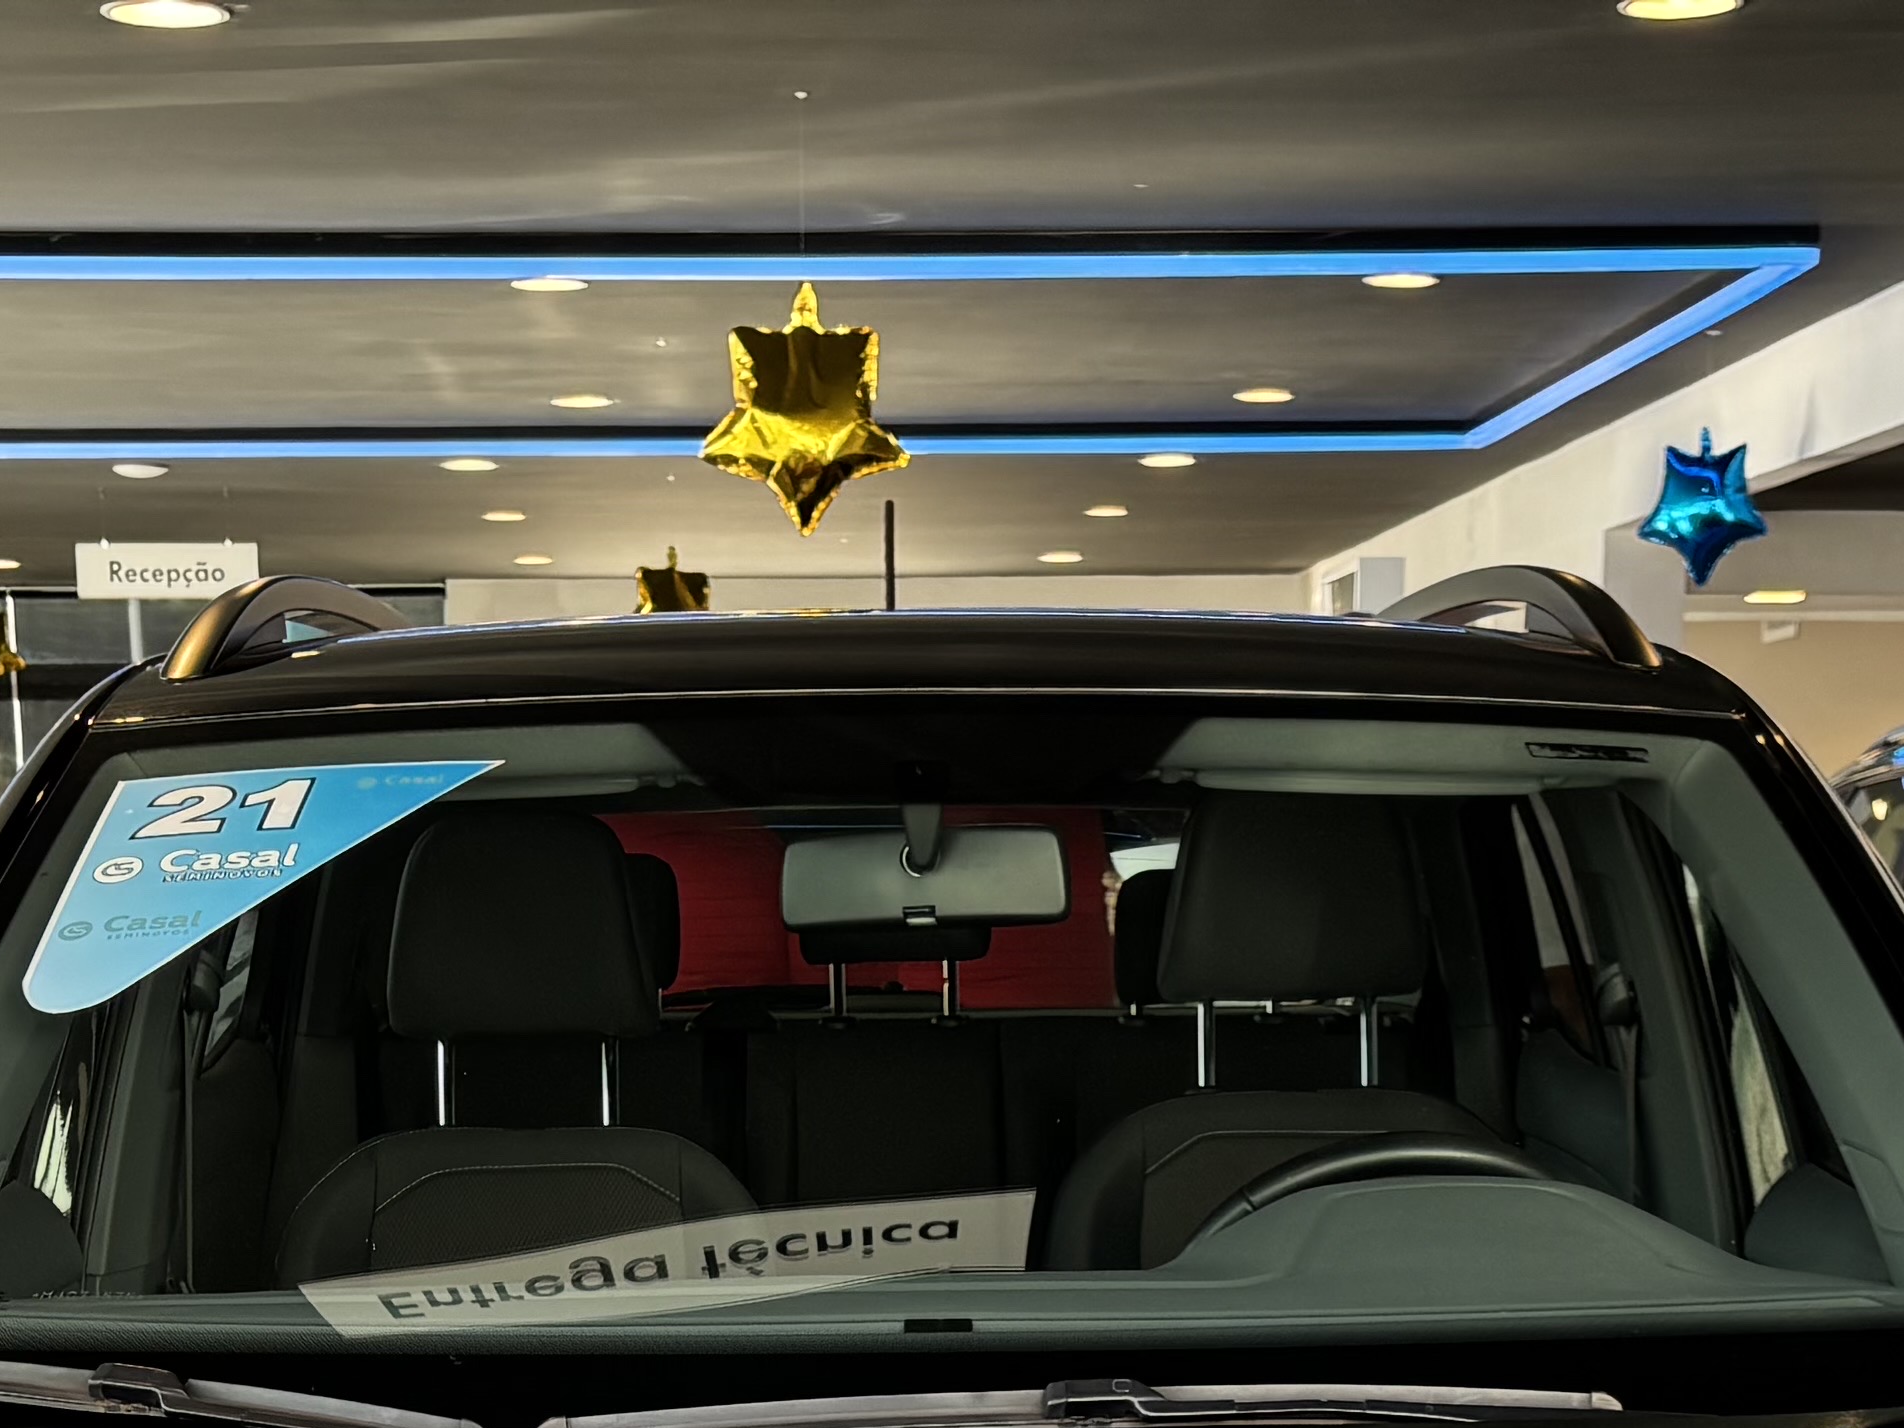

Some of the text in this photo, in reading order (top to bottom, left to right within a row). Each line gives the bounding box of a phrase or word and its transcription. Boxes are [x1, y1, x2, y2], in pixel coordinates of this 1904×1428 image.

[109, 560, 226, 588] Recepção
[129, 777, 316, 840] 21
[159, 843, 300, 873] Casal
[161, 867, 283, 883] SEMINOVOS
[104, 910, 202, 932] Casal
